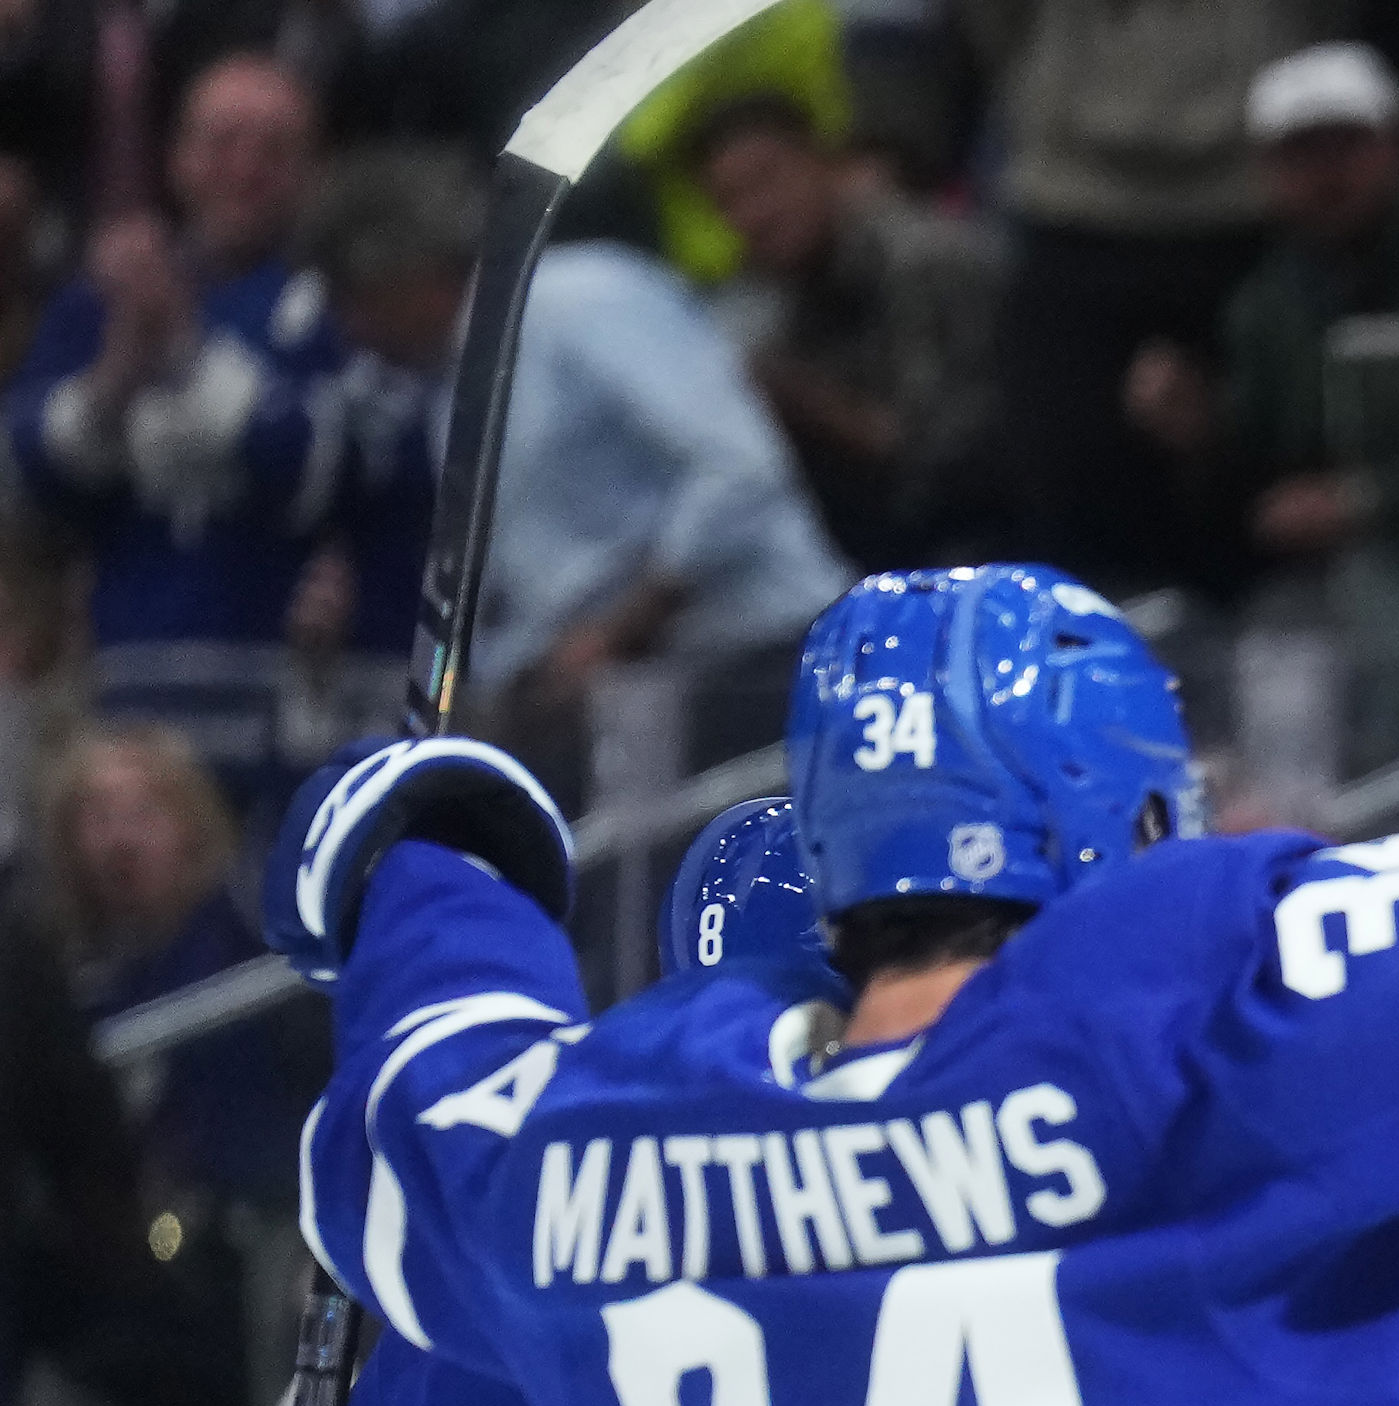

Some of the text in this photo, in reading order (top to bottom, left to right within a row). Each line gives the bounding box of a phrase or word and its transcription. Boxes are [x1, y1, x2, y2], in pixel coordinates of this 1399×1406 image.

[853, 691, 936, 771] 34
[698, 903, 725, 966] 8
[533, 1083, 1106, 1288] MATTHEWS
